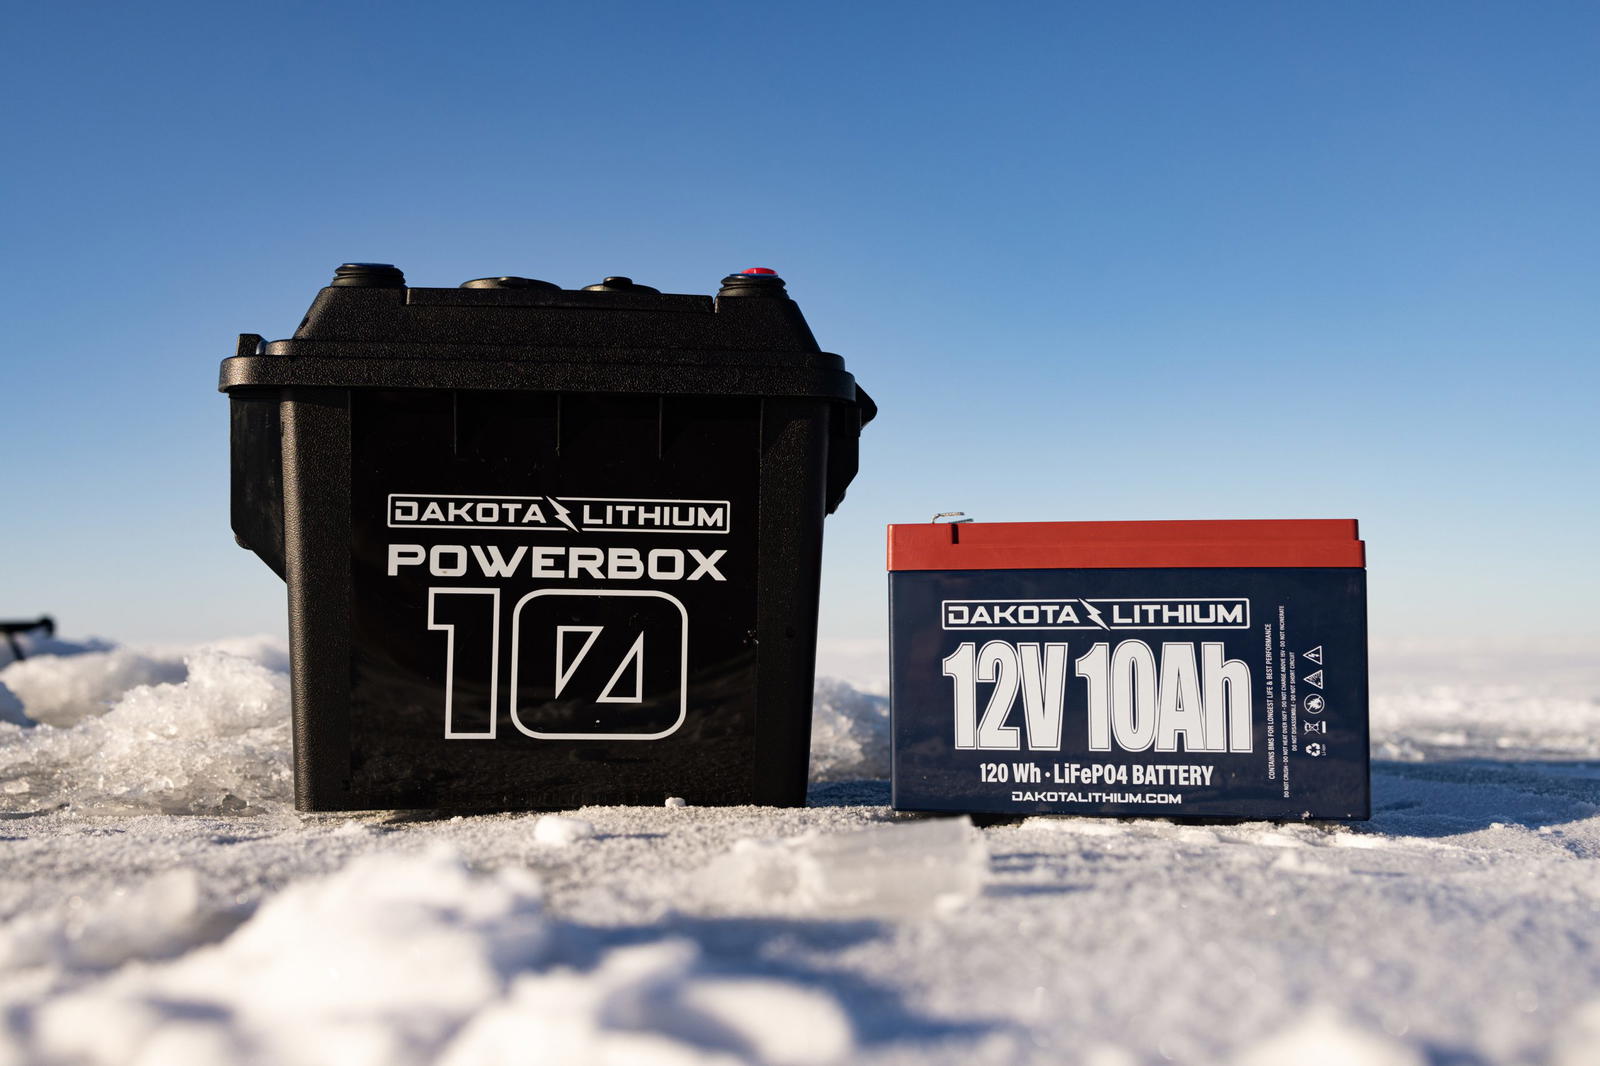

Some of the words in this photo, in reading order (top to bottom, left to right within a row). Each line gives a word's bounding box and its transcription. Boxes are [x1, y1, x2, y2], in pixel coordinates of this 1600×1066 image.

[394, 501, 547, 524] DAKOTA
[583, 504, 724, 527] LITHIUM
[387, 543, 728, 581] POWERBOX
[948, 605, 1080, 625] DAKOTA
[1112, 604, 1243, 624] LITHIUM
[1264, 623, 1272, 665] PERFORMANCE
[1279, 640, 1286, 648] DO
[427, 587, 688, 740] 10
[1265, 665, 1273, 680] BEST
[942, 639, 1068, 751] 12V
[1075, 639, 1253, 753] 10Ah
[1290, 694, 1296, 702] DO
[1281, 700, 1287, 708] DO
[1266, 699, 1274, 725] LONGEST
[1267, 737, 1275, 751] BMS
[1291, 744, 1298, 752] DO
[1282, 755, 1289, 763] DO
[979, 763, 1009, 783] 120
[1012, 763, 1041, 784] Wh
[1053, 763, 1128, 785] LiFePO4
[1132, 765, 1214, 786] BATTERY
[1011, 791, 1182, 804] DAKOTALITHIUM.COM
[1283, 790, 1290, 798] DO
